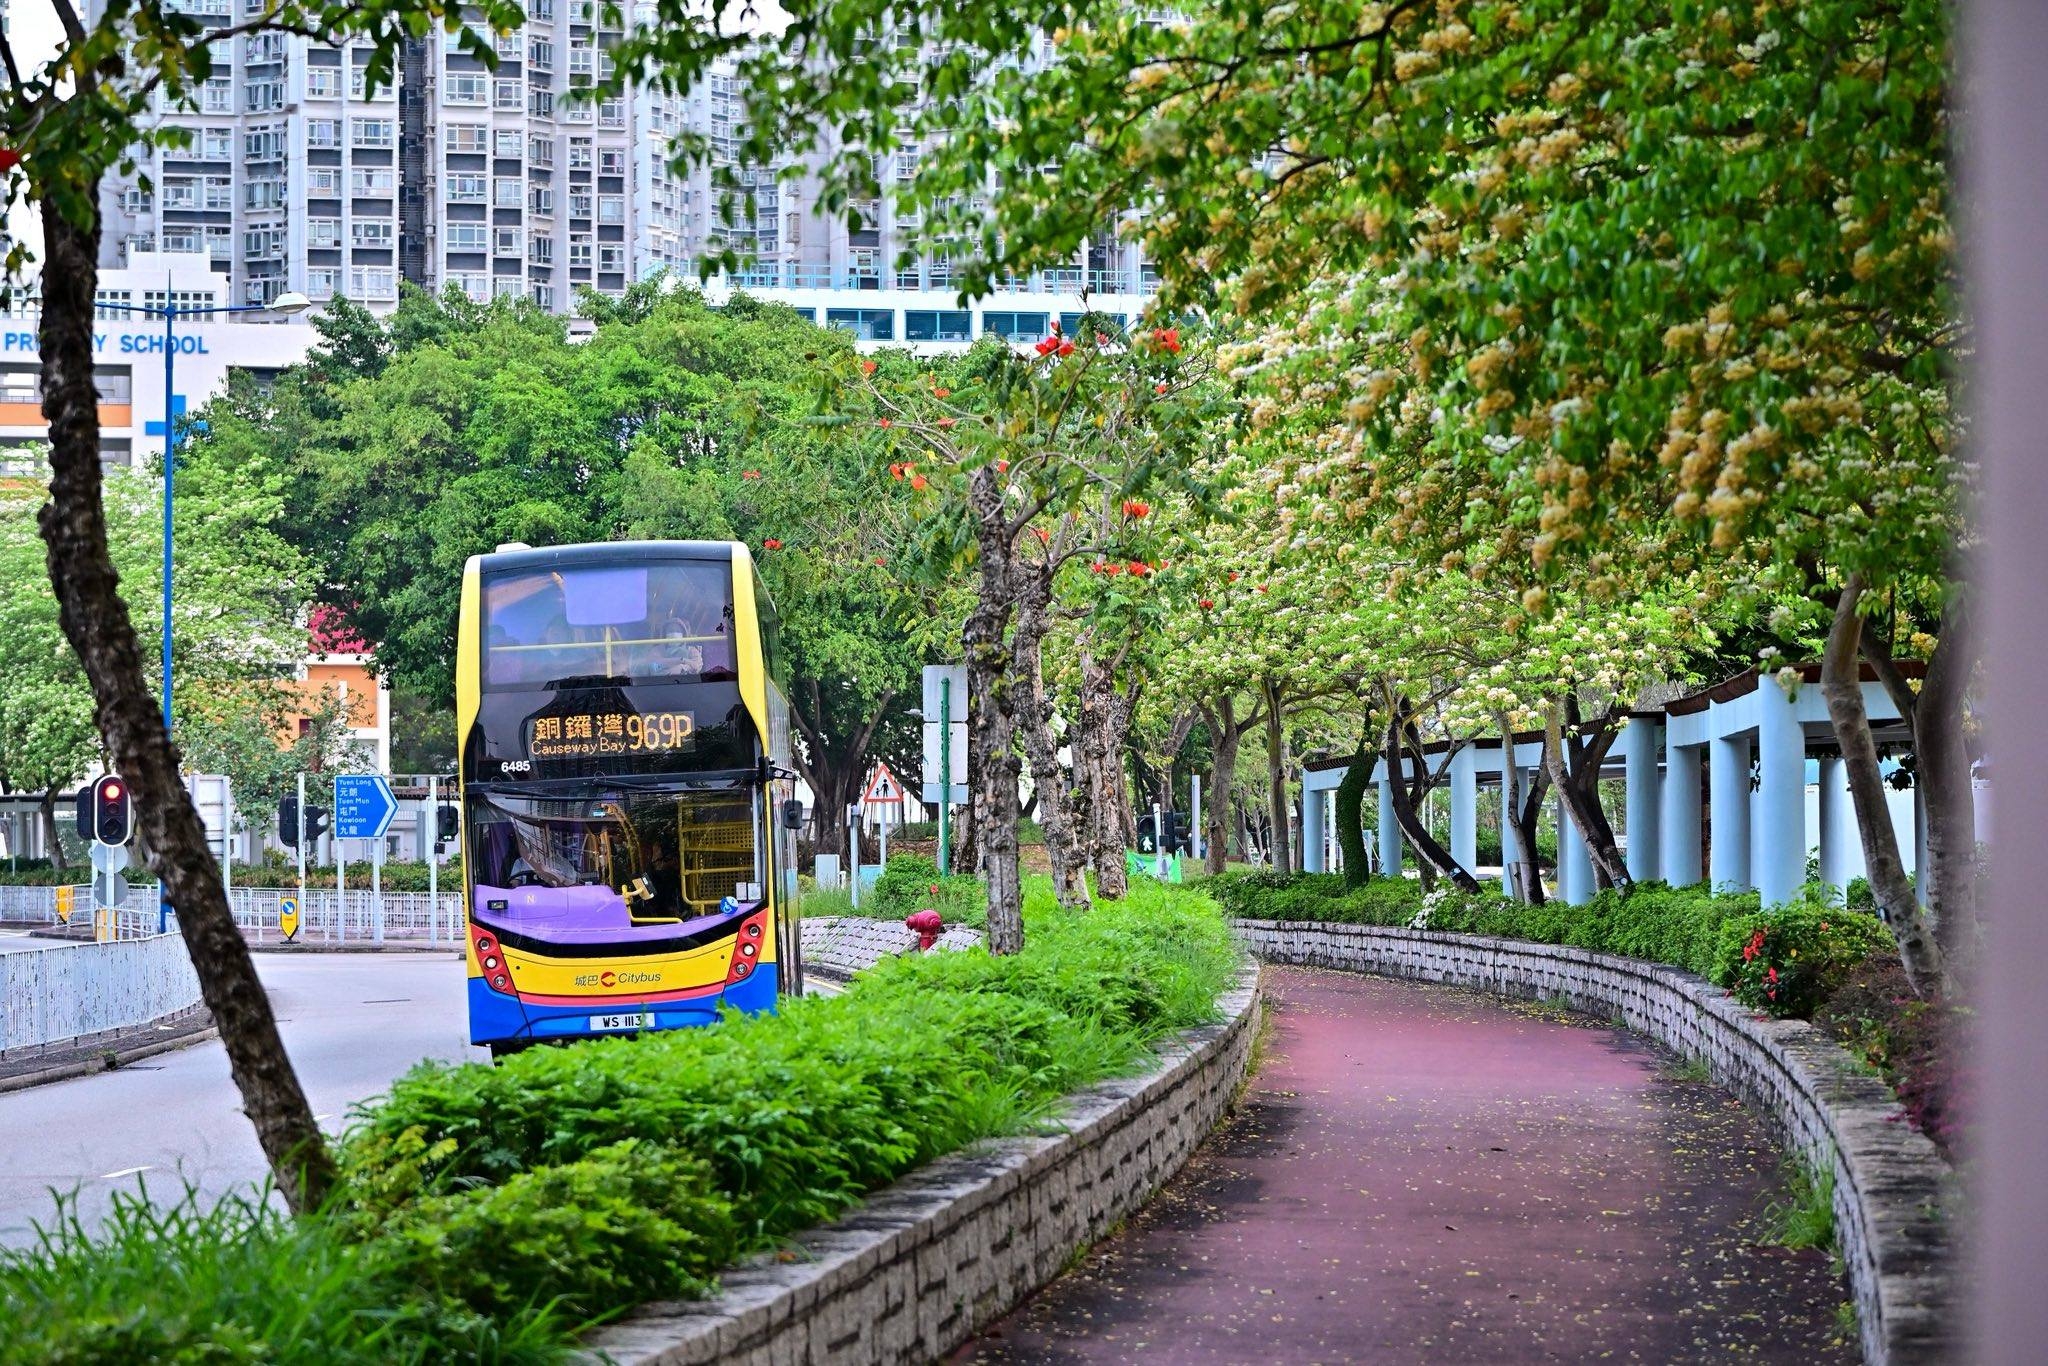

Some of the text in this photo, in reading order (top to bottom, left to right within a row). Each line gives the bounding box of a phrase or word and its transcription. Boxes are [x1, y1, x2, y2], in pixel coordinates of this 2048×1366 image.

[5, 332, 209, 354] PRIY SCHOOL
[535, 714, 623, 740] 銅鑼灣
[626, 713, 692, 750] 969P
[531, 736, 627, 755] Causeway Bay
[501, 760, 530, 772] 6485
[356, 778, 371, 786] Long
[340, 788, 357, 796] 元朗
[340, 806, 357, 815] 屯門
[340, 825, 357, 834] 九龍
[575, 975, 598, 986] 城巴
[618, 971, 661, 984] Citybus
[603, 1016, 619, 1028] WS
